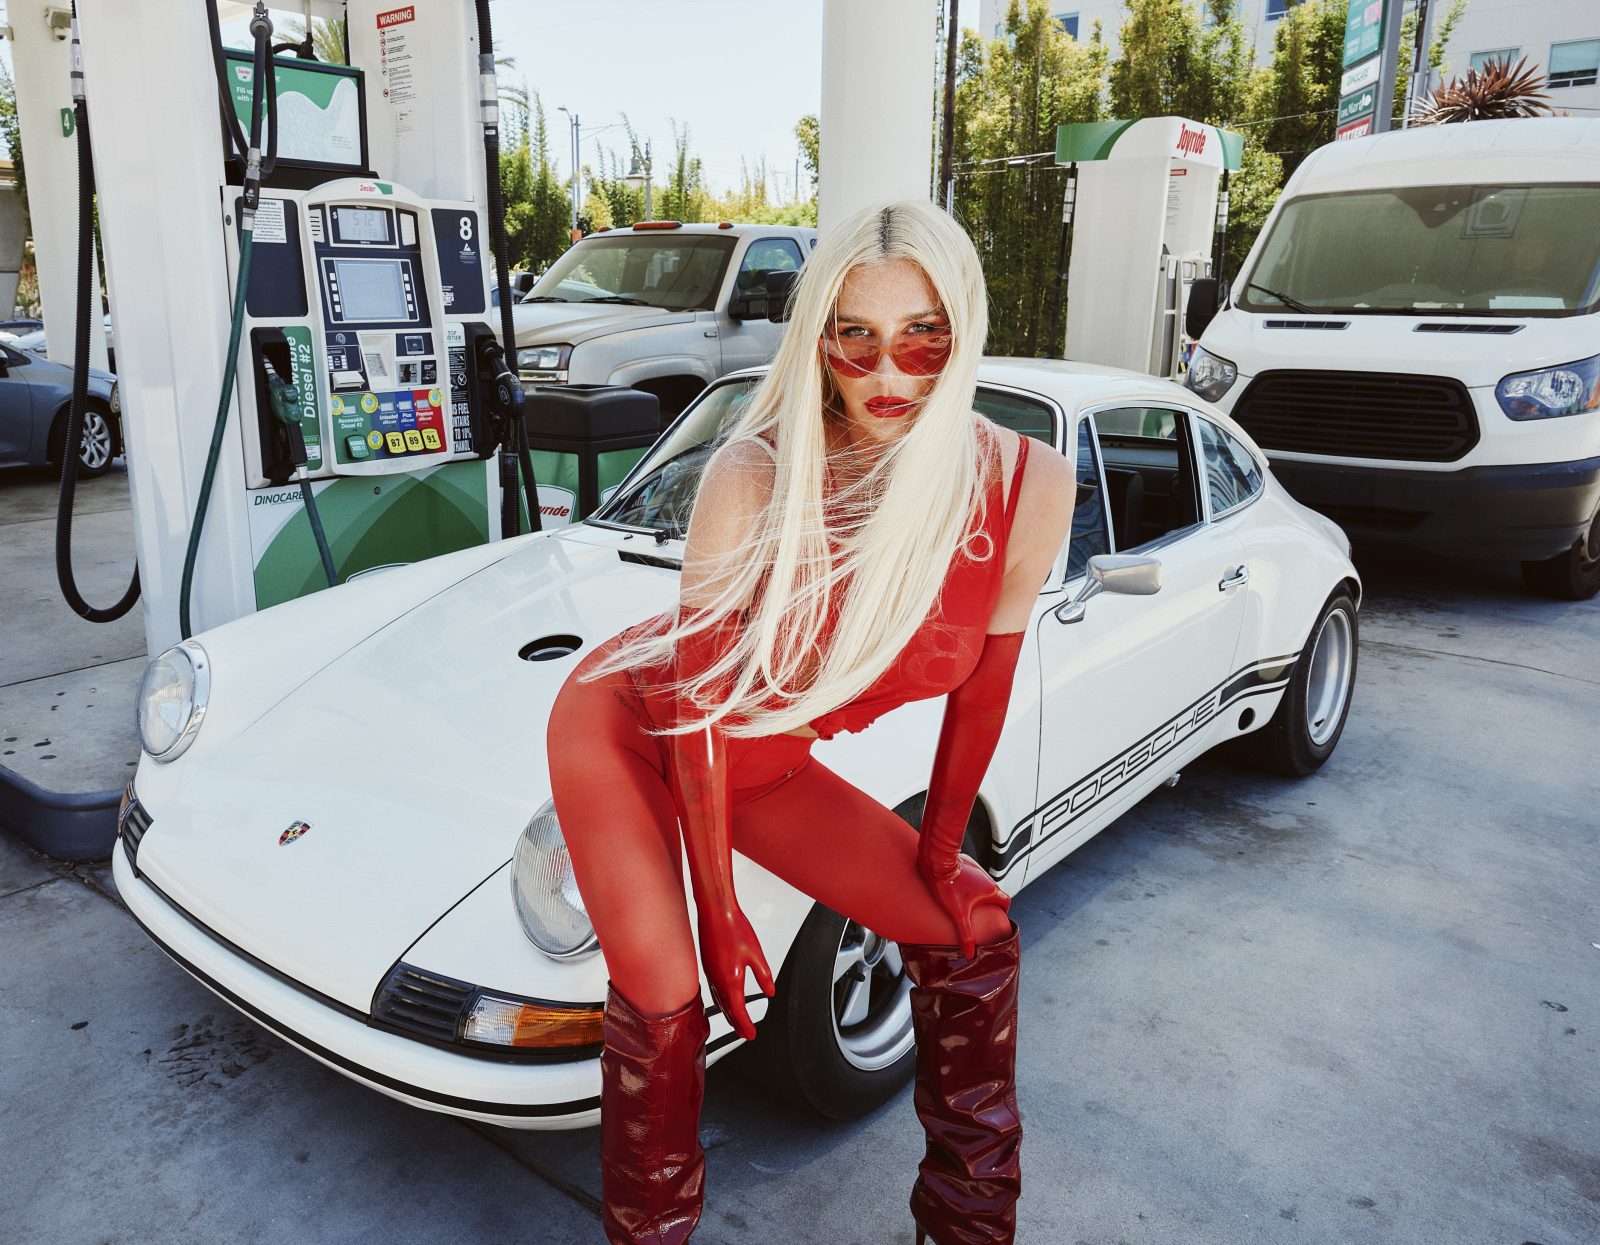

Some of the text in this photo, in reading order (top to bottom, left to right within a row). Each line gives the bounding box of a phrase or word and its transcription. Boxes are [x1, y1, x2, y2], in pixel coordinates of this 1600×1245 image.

[379, 9, 412, 26] WARNING
[236, 86, 246, 94] Fill
[63, 112, 70, 130] 4
[1176, 122, 1206, 158] Joyride
[332, 211, 338, 219] $
[459, 216, 473, 241] 8
[298, 344, 312, 364] #2
[301, 368, 316, 418] Diesel
[458, 402, 470, 415] FUEL
[390, 438, 401, 447] 87
[408, 436, 419, 445] 89
[426, 434, 437, 443] 91
[1039, 694, 1217, 836] PORSCHE
